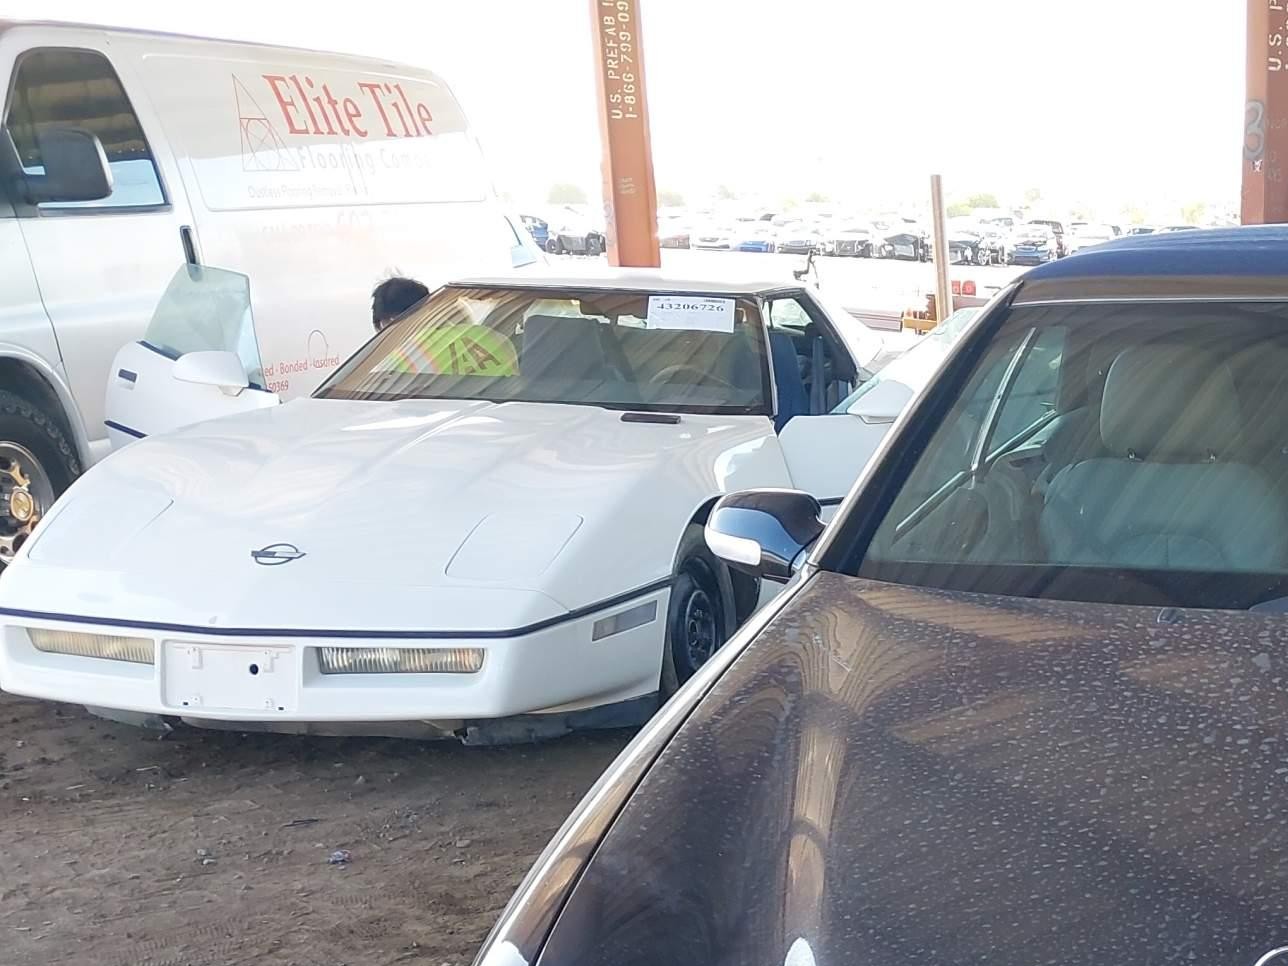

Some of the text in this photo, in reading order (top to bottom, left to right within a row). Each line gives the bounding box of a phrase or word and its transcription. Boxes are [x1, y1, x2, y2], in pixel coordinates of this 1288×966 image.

[603, 14, 621, 79] PREFAB
[1268, 26, 1283, 71] U.S.
[262, 74, 433, 138] Elite Tile
[656, 303, 725, 312] 43206726
[279, 360, 308, 375] Bonded
